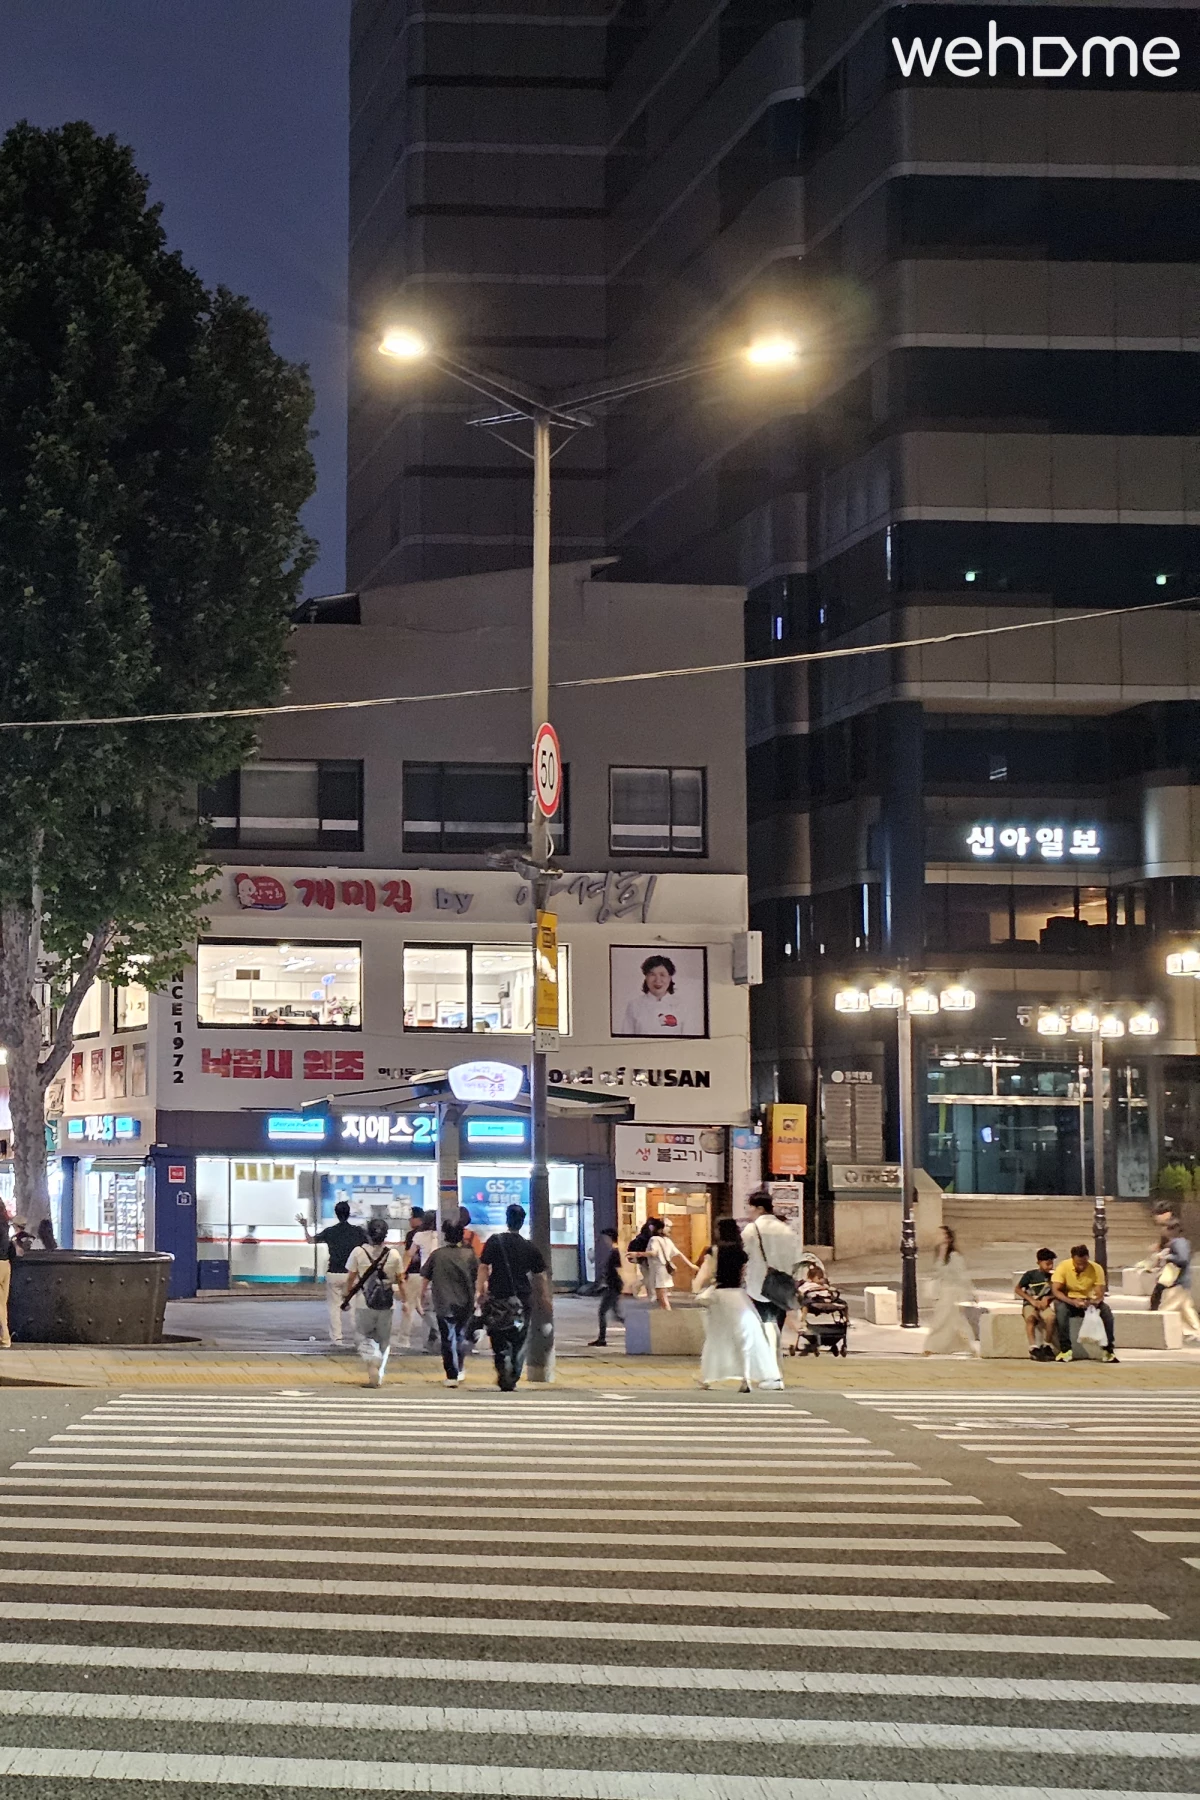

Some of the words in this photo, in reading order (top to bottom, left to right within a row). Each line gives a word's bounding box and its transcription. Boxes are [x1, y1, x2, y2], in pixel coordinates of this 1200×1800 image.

[540, 749, 555, 791] 50
[965, 826, 1101, 858] 신아일보
[293, 878, 413, 914] 개미집
[435, 887, 475, 915] by
[515, 870, 658, 925] 경희
[201, 1047, 293, 1079] 낙곱새
[303, 1049, 365, 1081] 원조
[632, 1068, 711, 1088] BUSAN
[777, 1135, 805, 1145] Alpha
[635, 1147, 651, 1162] 생
[656, 1147, 703, 1163] 불고기
[485, 1179, 524, 1193] GS25
